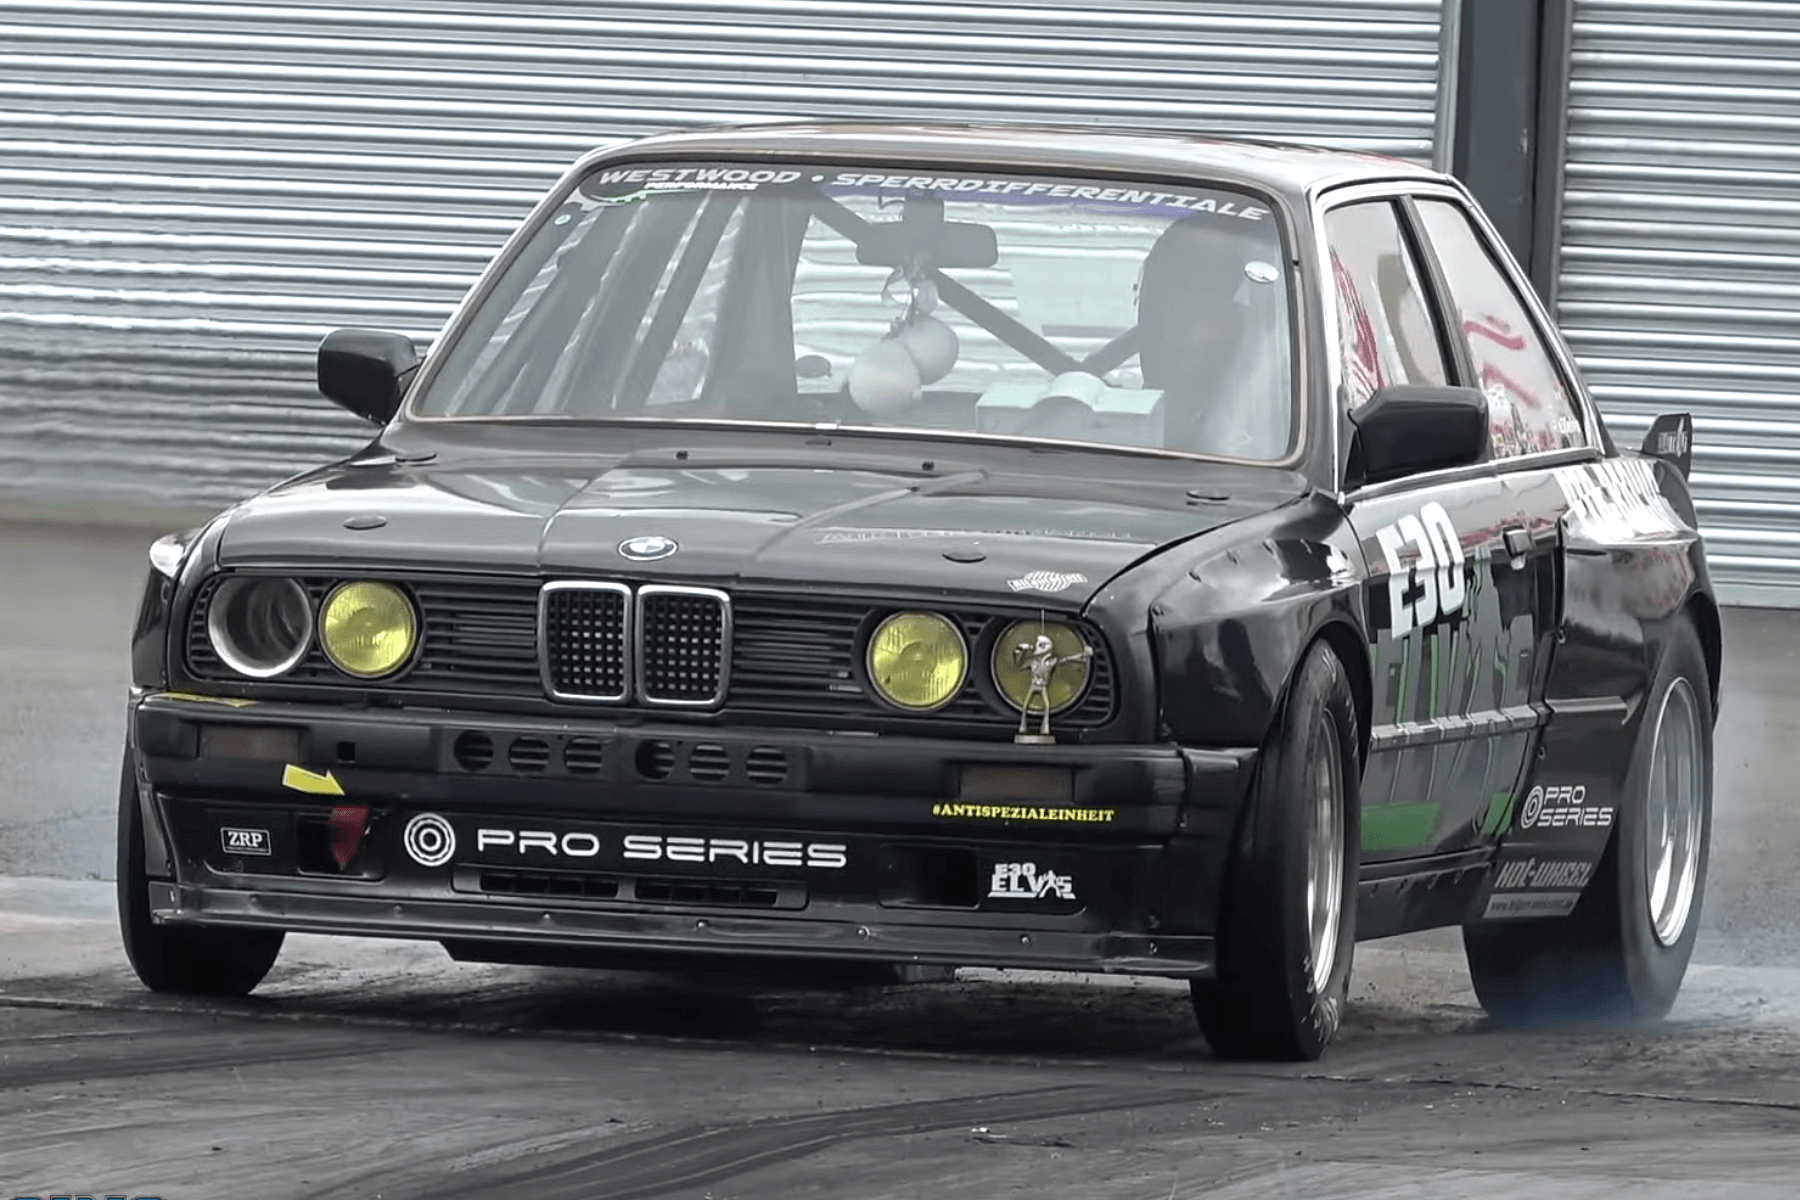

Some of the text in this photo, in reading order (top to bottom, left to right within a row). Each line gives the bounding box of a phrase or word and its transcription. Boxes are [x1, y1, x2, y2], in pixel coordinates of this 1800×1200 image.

[600, 168, 1270, 221] WESTWOOD SPERRDIFFERENTIALE
[1375, 500, 1465, 640] E30
[1544, 785, 1586, 805] PRO
[932, 803, 1115, 822] #ANTISPEZIALEINHEIT
[1537, 807, 1614, 827] SERIES
[228, 830, 264, 848] ZRP
[477, 828, 848, 869] PRO SERIES
[994, 861, 1037, 877] E30
